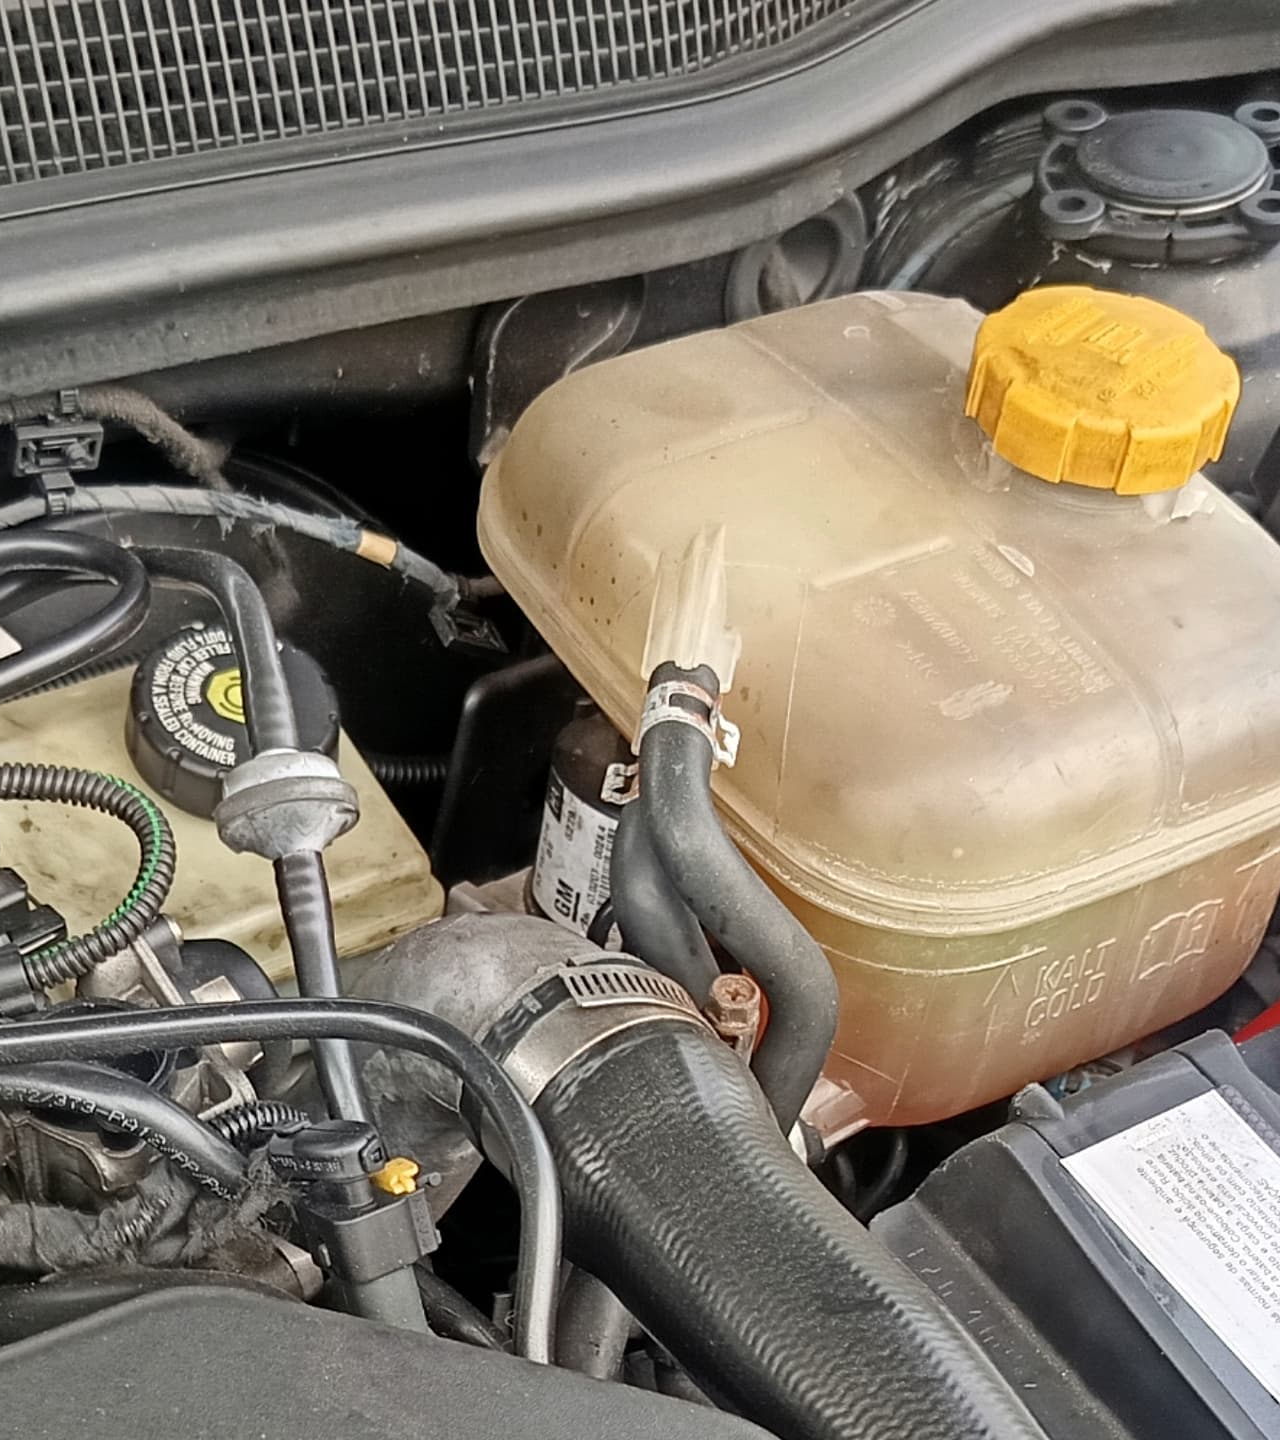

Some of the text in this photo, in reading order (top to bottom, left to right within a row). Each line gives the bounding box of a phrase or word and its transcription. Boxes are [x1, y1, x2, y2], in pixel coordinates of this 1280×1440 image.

[166, 636, 198, 662] FLUID
[152, 658, 175, 685] FROM
[152, 685, 168, 696] A
[186, 661, 216, 704] WARNING
[152, 695, 181, 733] SEALED
[169, 642, 235, 752] FILLER CAP BEFORE REMOVING
[174, 729, 236, 767] CONTAINER
[554, 877, 575, 917] GM
[1034, 937, 1117, 998] KALT
[1025, 972, 1107, 1028] COLD
[1180, 1214, 1227, 1260] segurança
